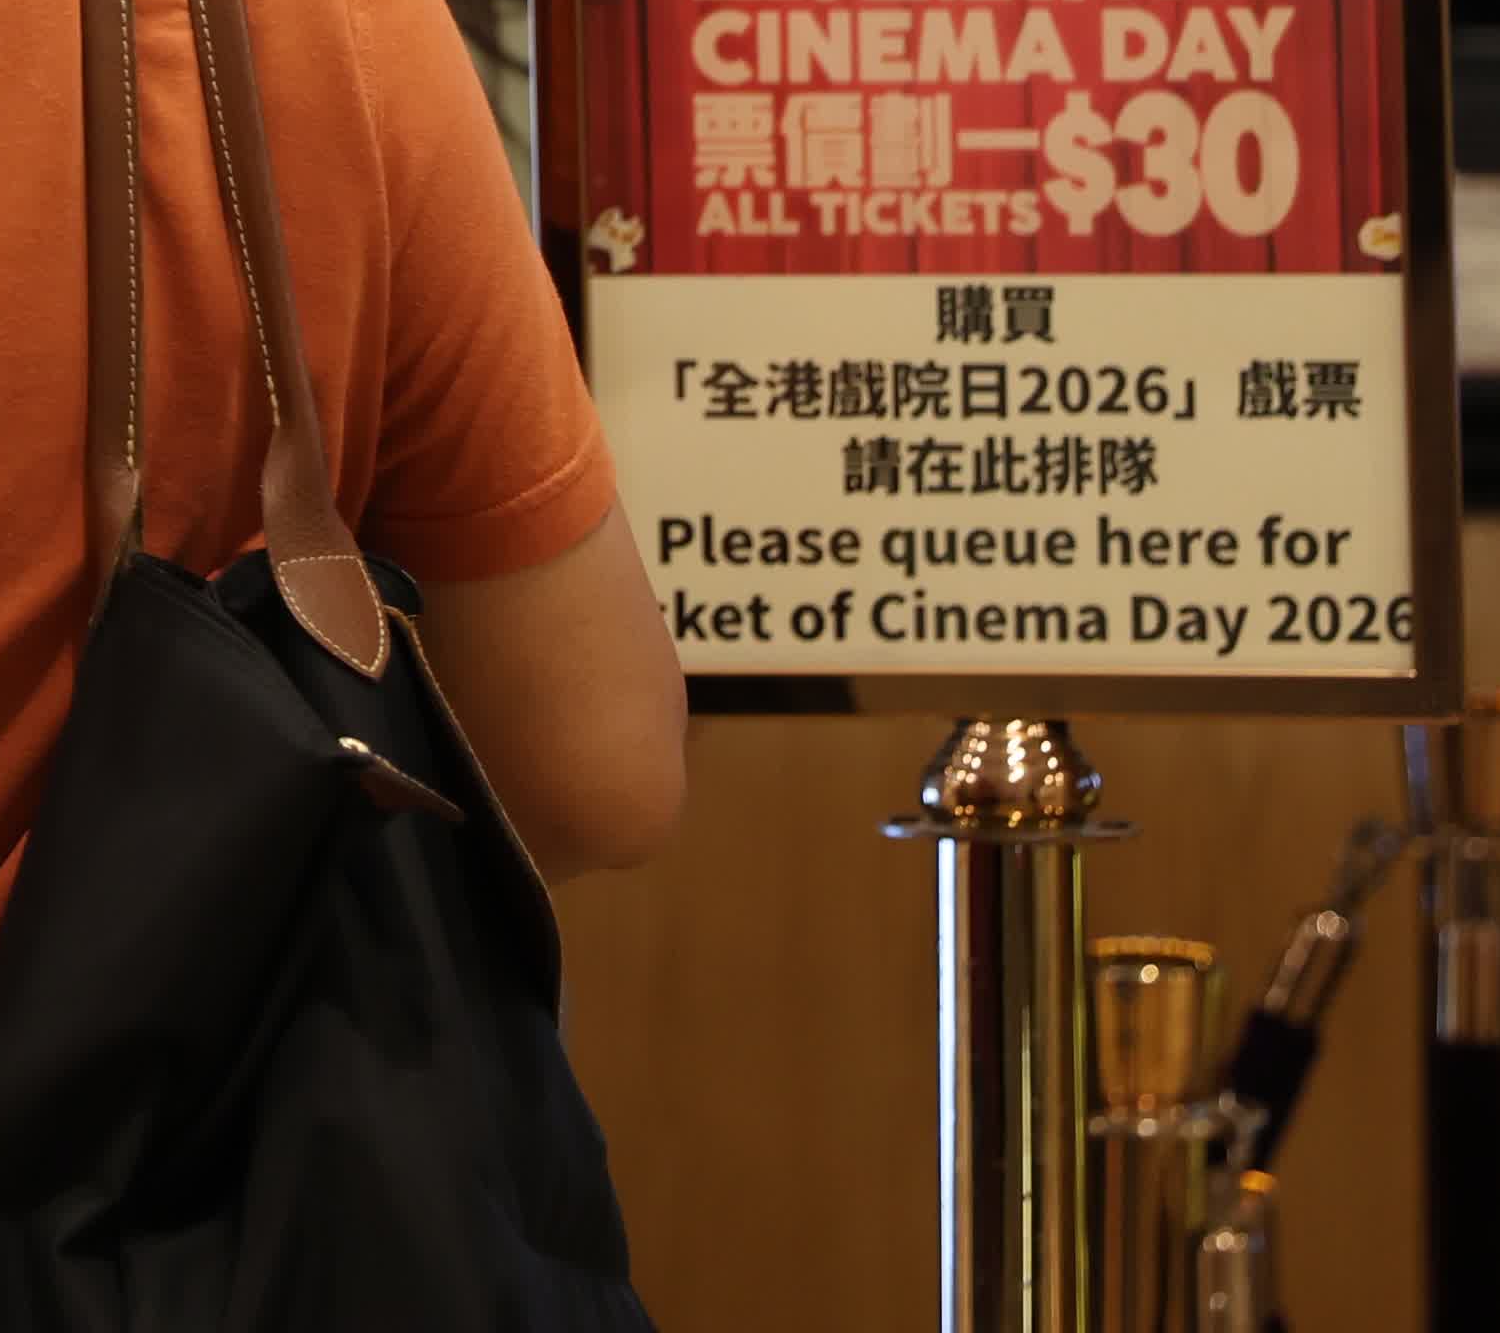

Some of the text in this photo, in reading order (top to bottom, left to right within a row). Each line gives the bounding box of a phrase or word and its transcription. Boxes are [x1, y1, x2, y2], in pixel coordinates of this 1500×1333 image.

[692, 6, 1296, 85] CINEMA DAY
[692, 89, 1299, 238] 票價劃一 $30
[696, 189, 1043, 238] ALL TICKETS
[935, 284, 1056, 345] 購買
[1236, 359, 1364, 421] 戲票
[841, 435, 1159, 497] 請在此排隊
[658, 513, 1353, 578] Please queue here for
[659, 588, 1414, 657] ket of Cinema Day 2026
